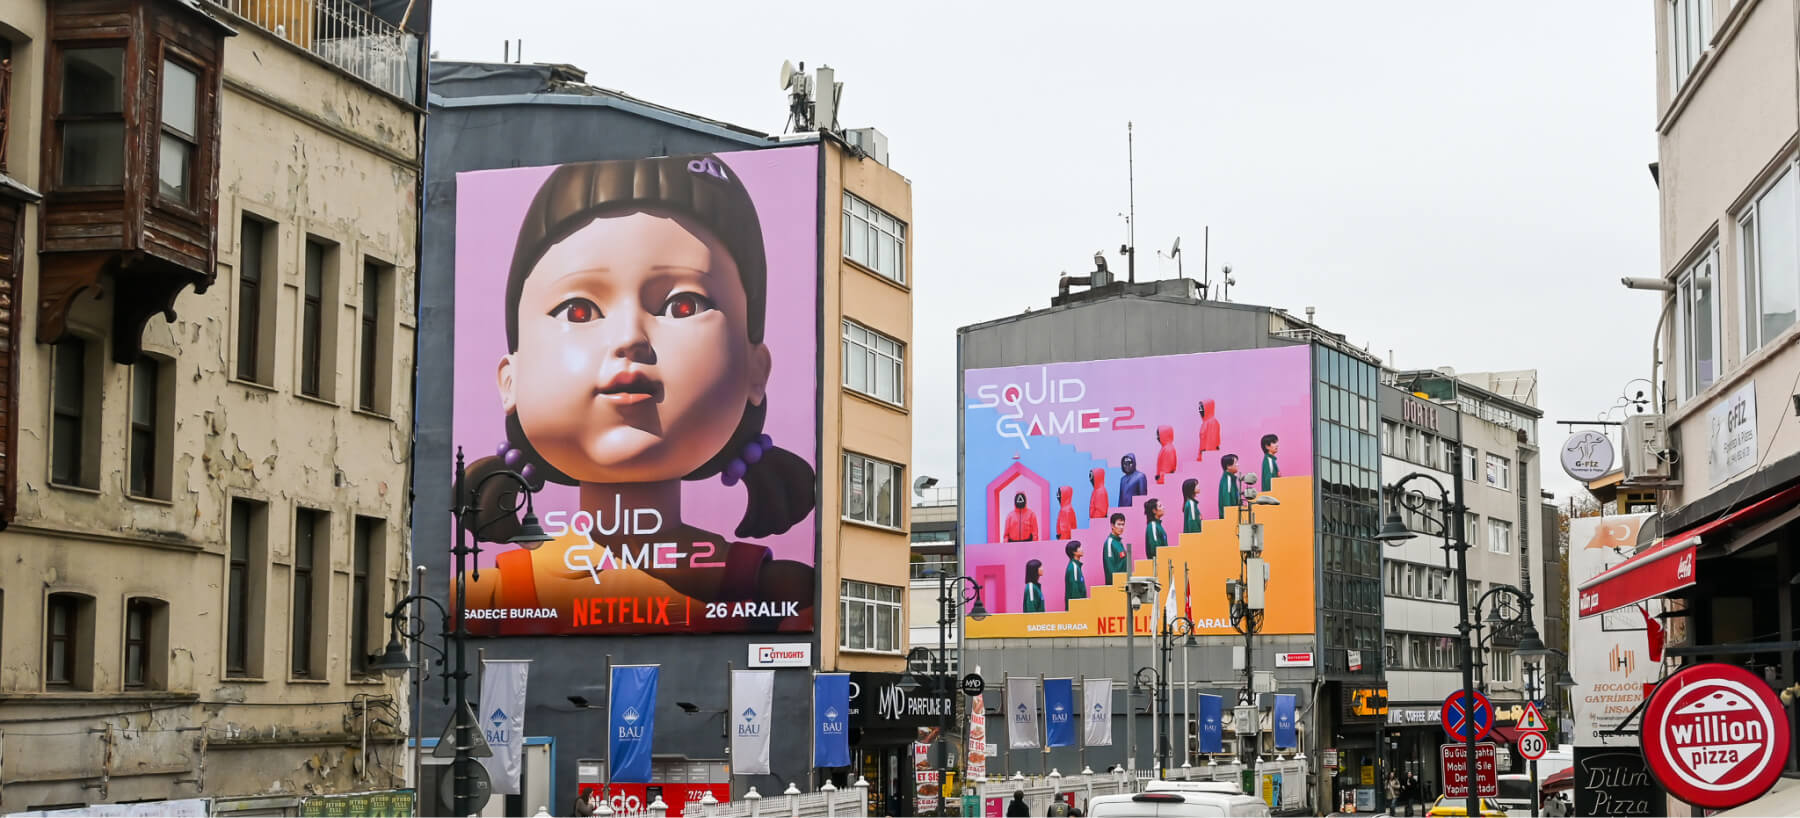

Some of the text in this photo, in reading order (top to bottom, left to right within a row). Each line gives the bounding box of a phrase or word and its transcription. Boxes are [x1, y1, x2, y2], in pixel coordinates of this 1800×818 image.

[968, 366, 1087, 410] SQUID
[996, 406, 1145, 450] GAME 2
[544, 493, 663, 537] SQUID
[564, 541, 726, 585] GAME 2
[464, 597, 799, 627] SADECE BURADA NETFLIX 26 ARALIK
[1027, 624, 1056, 632] SADECE
[1057, 623, 1088, 632] BURADA
[1098, 615, 1153, 634] NETLI
[770, 651, 805, 659] CITYLIGHTS
[879, 682, 905, 719] MAD
[908, 697, 951, 715] PARFUMER
[823, 722, 842, 732] BAU
[1052, 713, 1068, 721] BAU
[486, 729, 510, 743] BAU
[618, 726, 644, 738] BAU
[738, 724, 760, 735] BAU
[1671, 714, 1762, 745] willion
[1444, 748, 1454, 758] Bu
[1524, 739, 1541, 752] 30
[1447, 761, 1467, 771] Mobil
[1692, 747, 1738, 770] pizza
[1585, 767, 1649, 789] Dilim
[1588, 790, 1649, 815] Pizza
